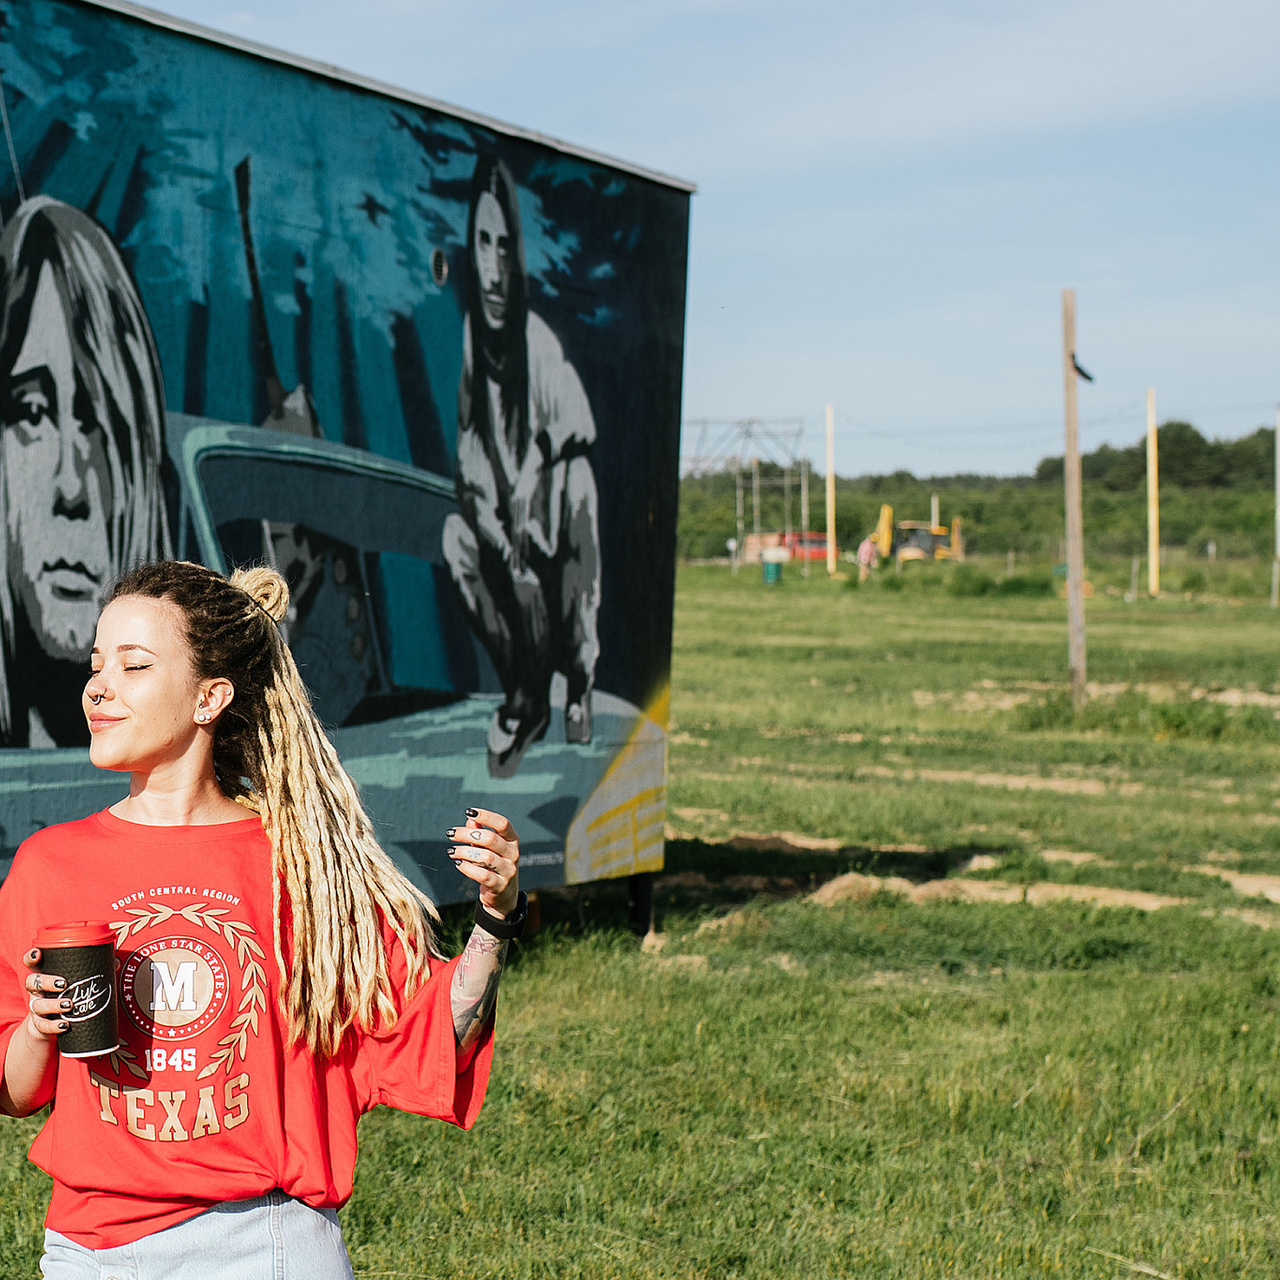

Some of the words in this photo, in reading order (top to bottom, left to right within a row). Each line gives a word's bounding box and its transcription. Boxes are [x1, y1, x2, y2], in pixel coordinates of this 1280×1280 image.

[111, 891, 145, 910] SOUTH
[149, 886, 198, 897] CENTRAL
[202, 888, 240, 906] REGION
[123, 964, 136, 991] THE
[133, 941, 167, 963] LONE
[170, 939, 203, 954] STAR
[203, 951, 225, 990] STATE
[150, 961, 197, 1011] M
[145, 1048, 196, 1072] 1845
[90, 1072, 250, 1142] TEXAS
